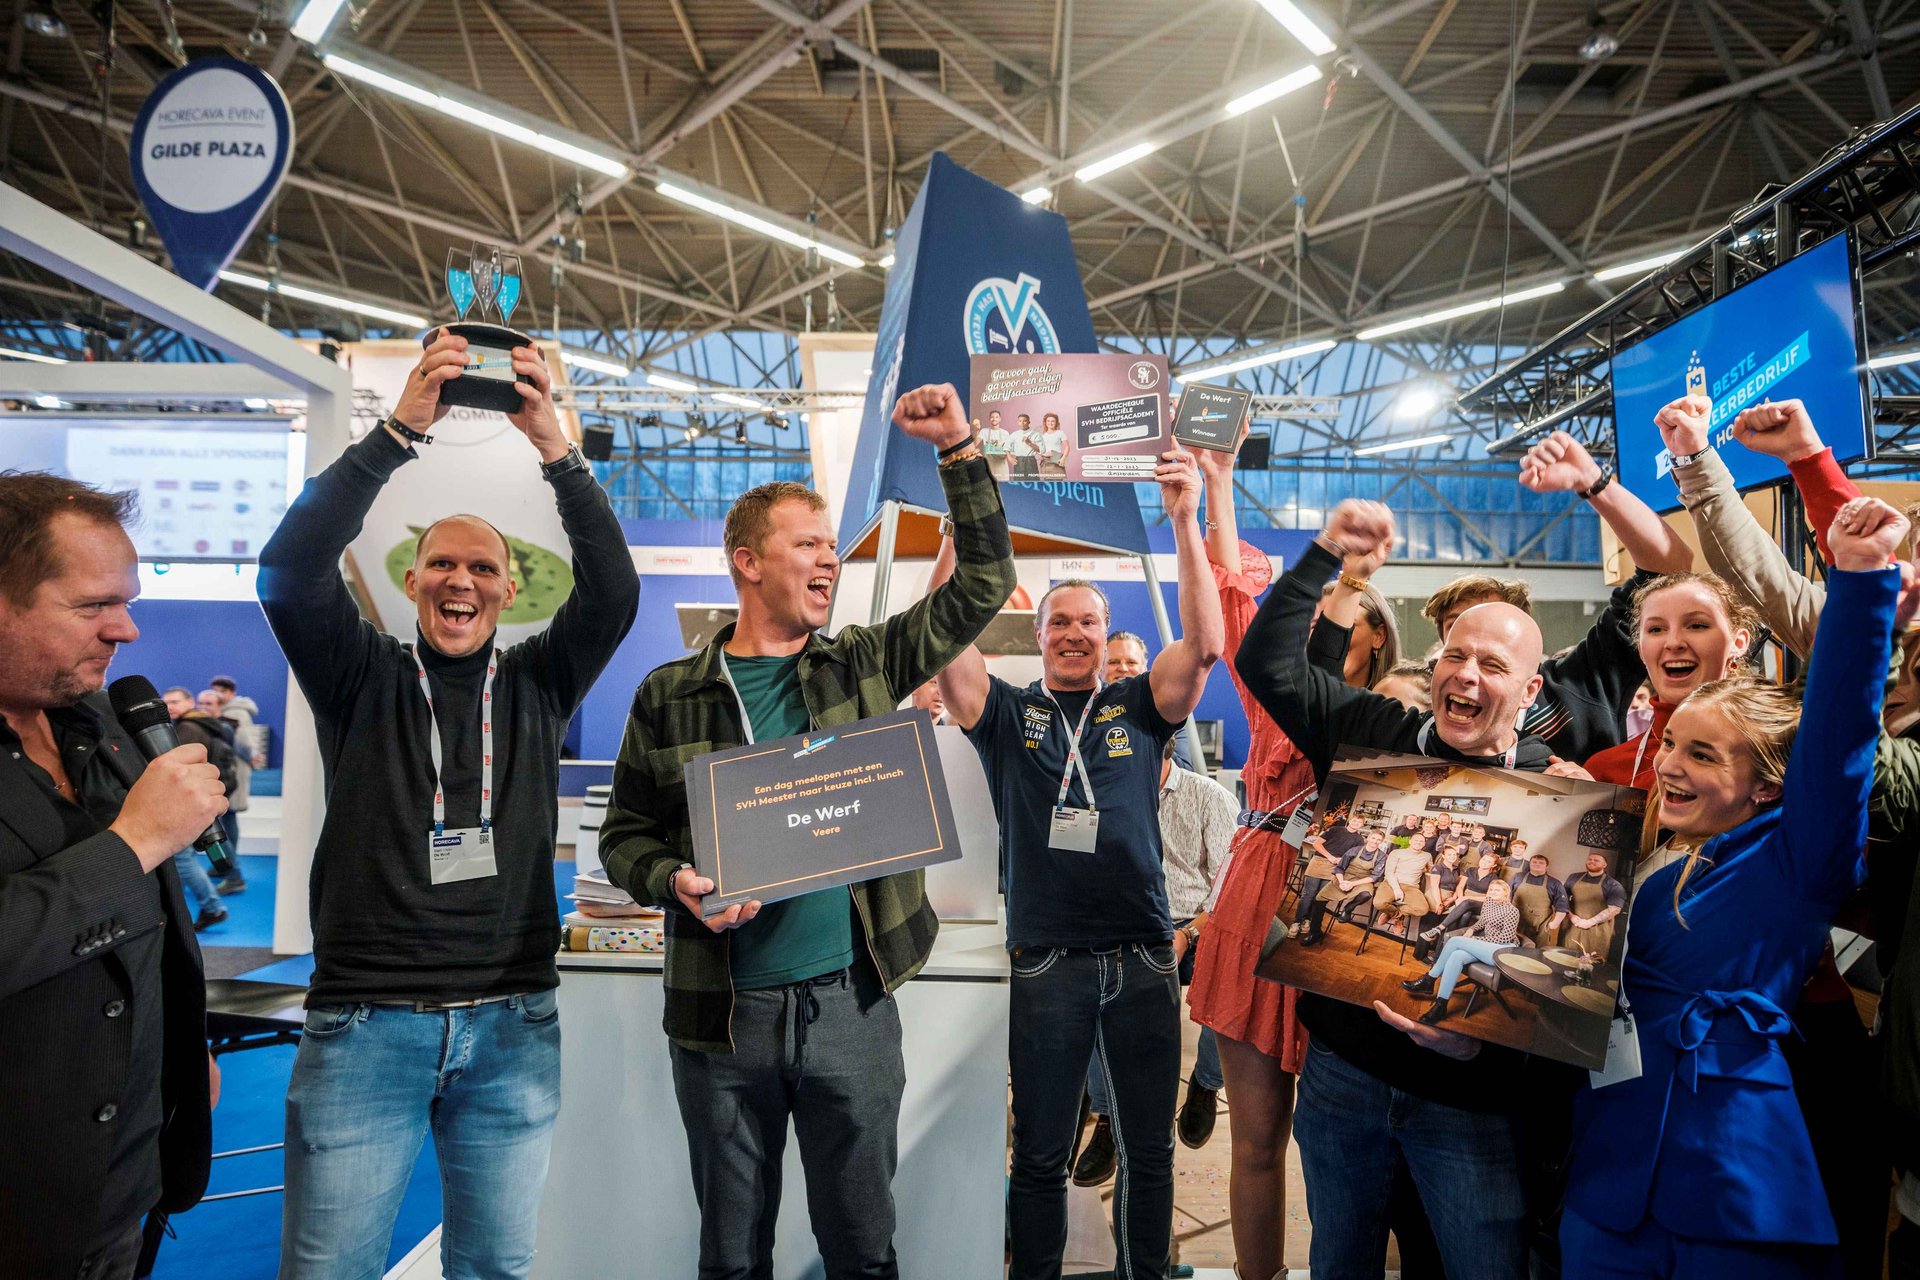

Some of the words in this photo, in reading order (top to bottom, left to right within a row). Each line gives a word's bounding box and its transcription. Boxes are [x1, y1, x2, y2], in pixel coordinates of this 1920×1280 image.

[158, 108, 224, 121] HORECAVA
[228, 107, 265, 120] EVENT
[151, 142, 202, 159] GILDE
[208, 142, 266, 158] PLAZA
[991, 369, 1004, 379] Ga
[1007, 368, 1025, 378] voor
[1713, 351, 1757, 399] BESTE
[982, 382, 1060, 402] bedrijfsacademy!
[987, 383, 999, 393] ga
[1001, 380, 1020, 389] voor
[1709, 345, 1799, 429] EERBEDRIJF
[1091, 399, 1144, 413] WAARDECHEQUE
[1212, 394, 1232, 404] Werf
[1096, 410, 1155, 425] BEDRIJFSACADEMY
[1102, 407, 1134, 417] OFFICIËLE
[1025, 708, 1051, 720] Petrol
[1025, 720, 1046, 733] HIGH
[1024, 730, 1044, 740] GEAR
[755, 785, 772, 795] Een
[774, 781, 793, 791] dag
[795, 771, 842, 786] meelopen
[844, 766, 863, 776] met
[865, 762, 883, 771] een
[736, 801, 757, 811] SVH
[759, 792, 797, 806] Meester
[800, 788, 822, 798] naar
[824, 781, 853, 792] keuze
[854, 775, 875, 786] incl.
[877, 769, 904, 781] lunch
[787, 813, 812, 828] De
[815, 800, 861, 822] Werf
[812, 826, 840, 838] Veere
